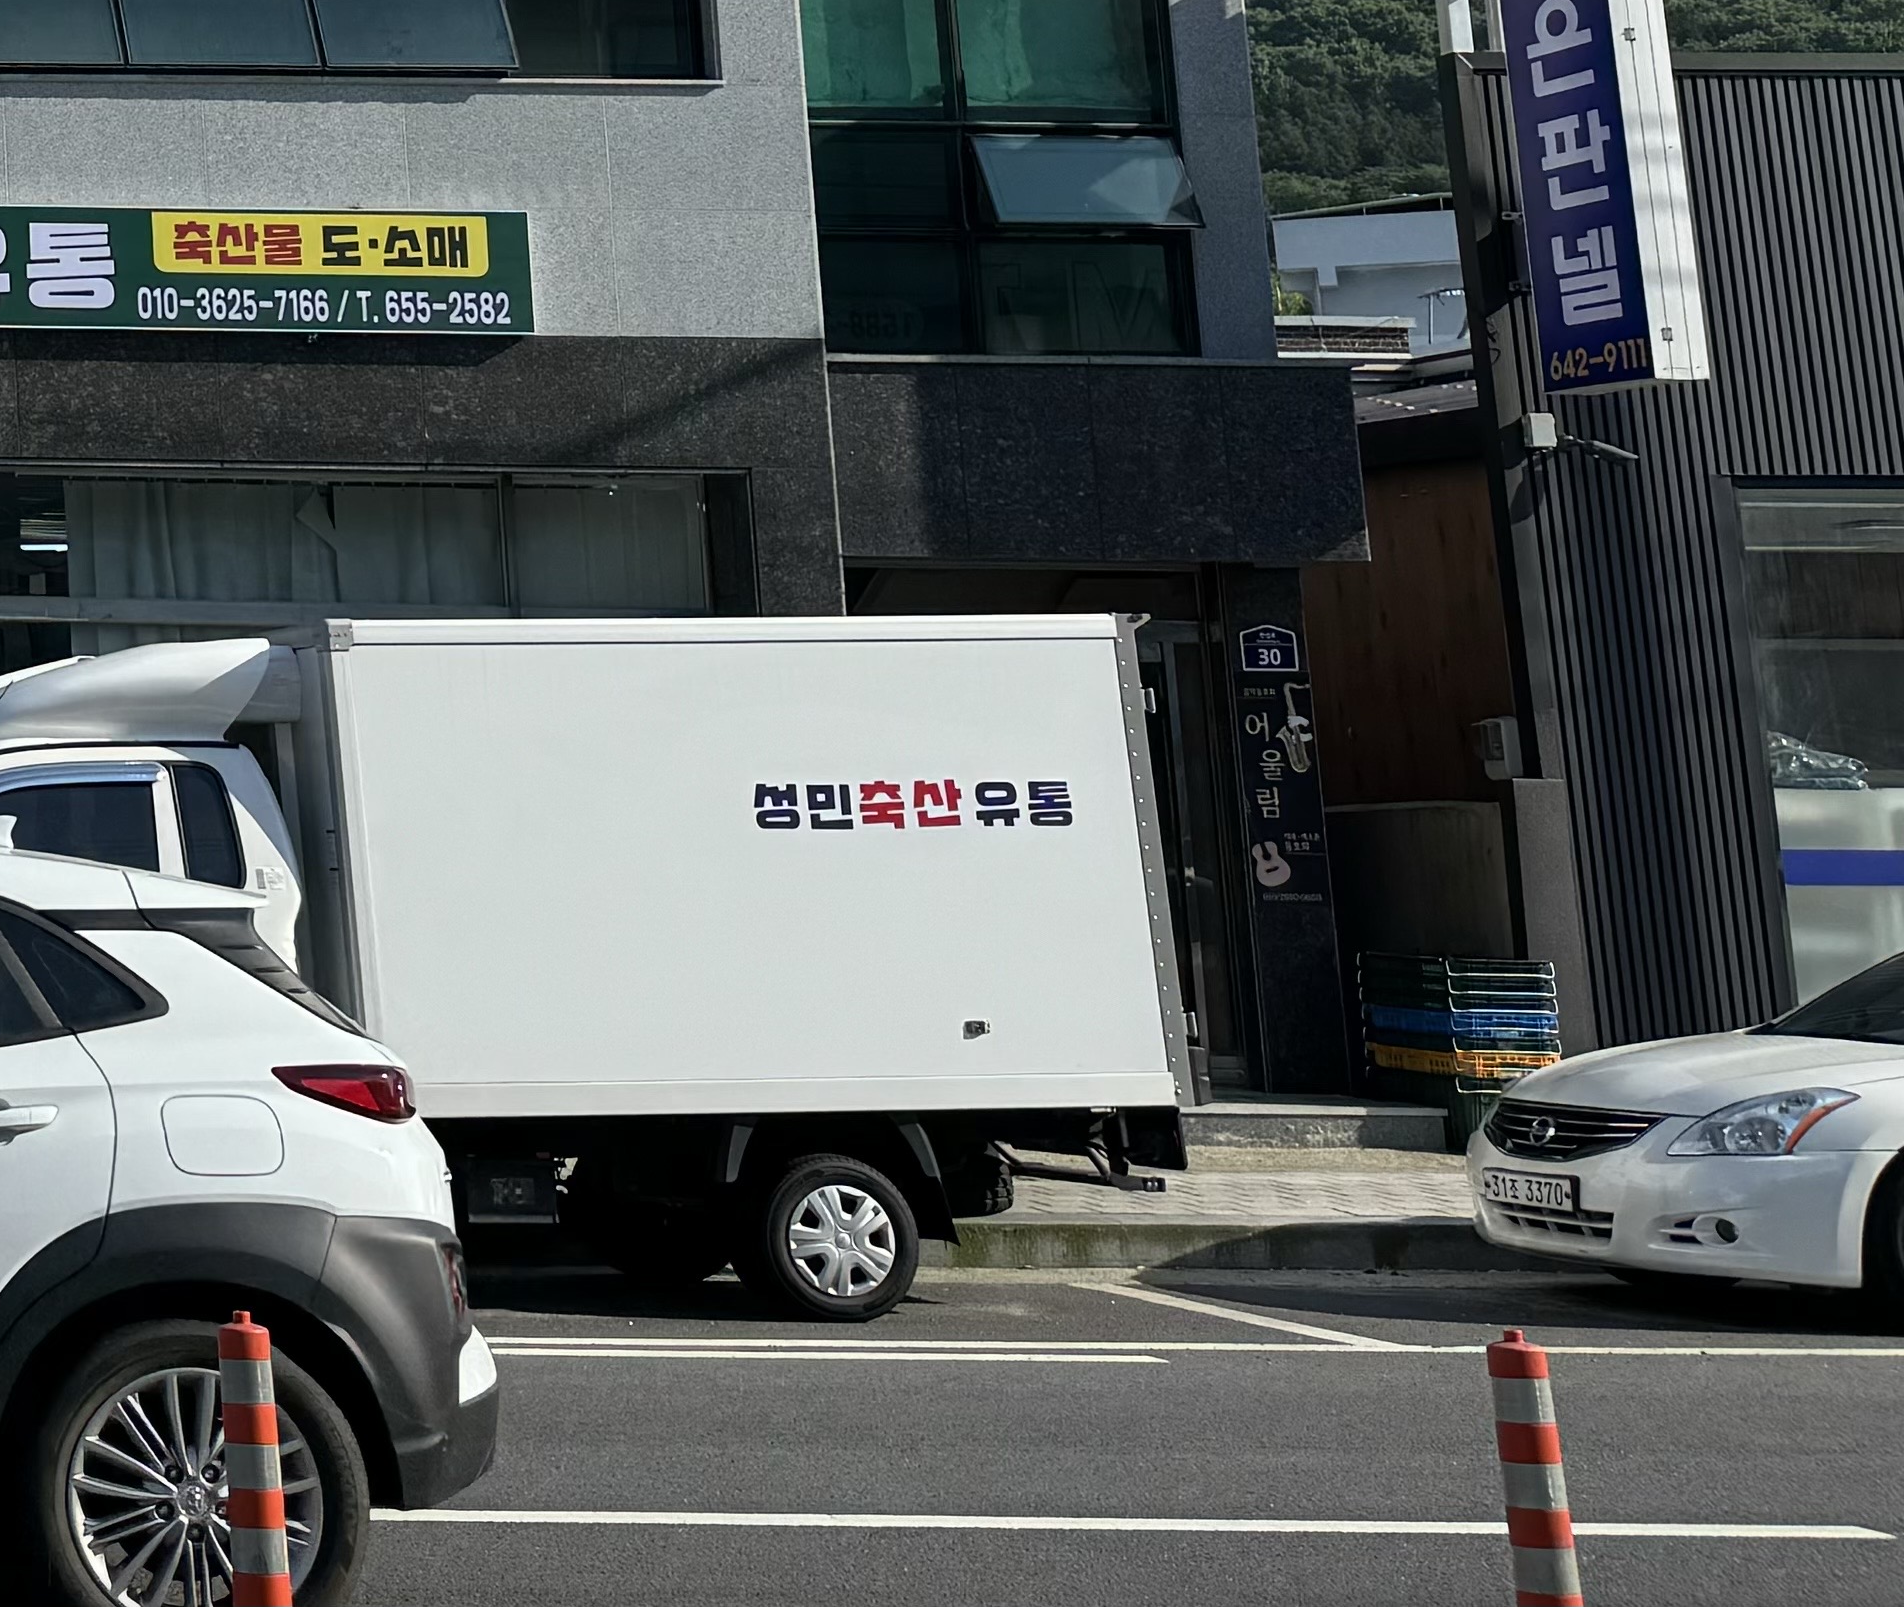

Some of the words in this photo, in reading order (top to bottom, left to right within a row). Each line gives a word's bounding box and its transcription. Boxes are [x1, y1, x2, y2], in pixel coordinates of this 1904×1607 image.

[173, 221, 302, 266] 축산물
[137, 286, 329, 323] 010-3625-7166
[1550, 335, 1648, 382] 642-9111
[1257, 647, 1281, 666] 30
[1525, 1179, 1564, 1206] 3370
